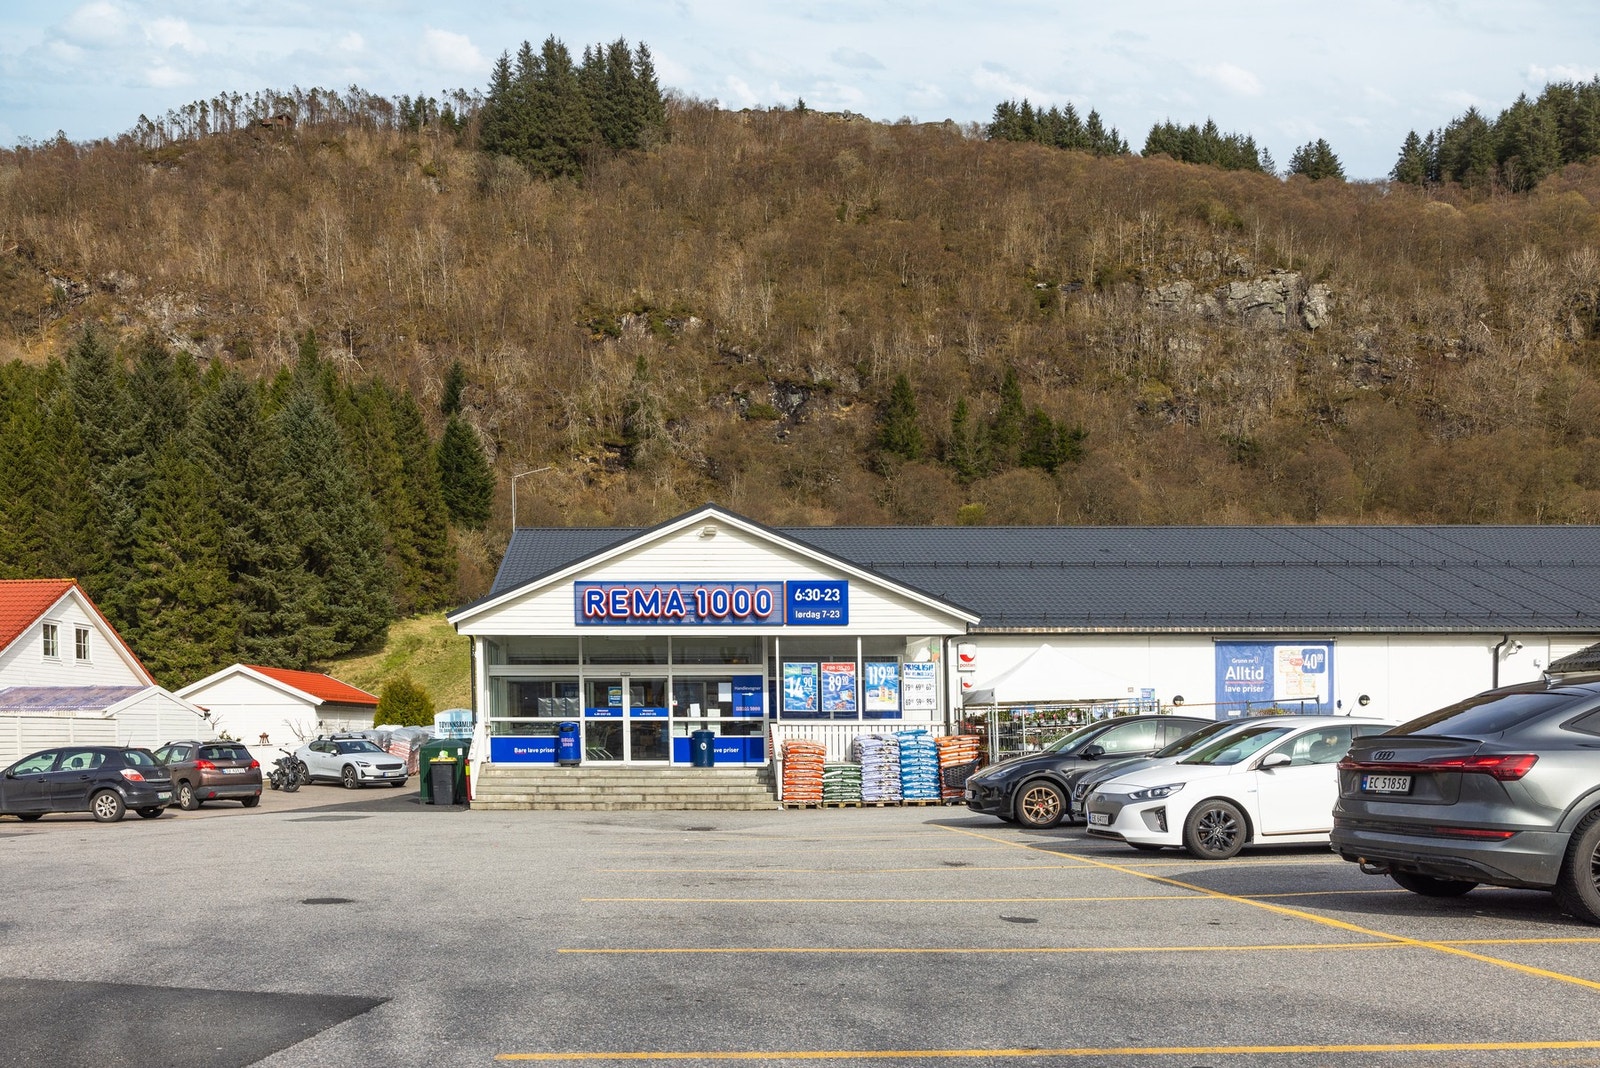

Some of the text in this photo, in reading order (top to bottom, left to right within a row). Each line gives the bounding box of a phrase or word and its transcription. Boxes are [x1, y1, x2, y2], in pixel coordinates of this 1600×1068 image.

[794, 588, 841, 602] 6:30-23
[584, 588, 774, 617] REMA 1000
[794, 609, 841, 620] lørdag 7-23
[1304, 653, 1317, 670] 40
[868, 666, 886, 685] 119
[1225, 666, 1264, 680] Alltid
[803, 677, 813, 687] 90
[828, 675, 842, 692] 89
[1242, 684, 1265, 693] priser
[1369, 777, 1408, 790] EC 51858
